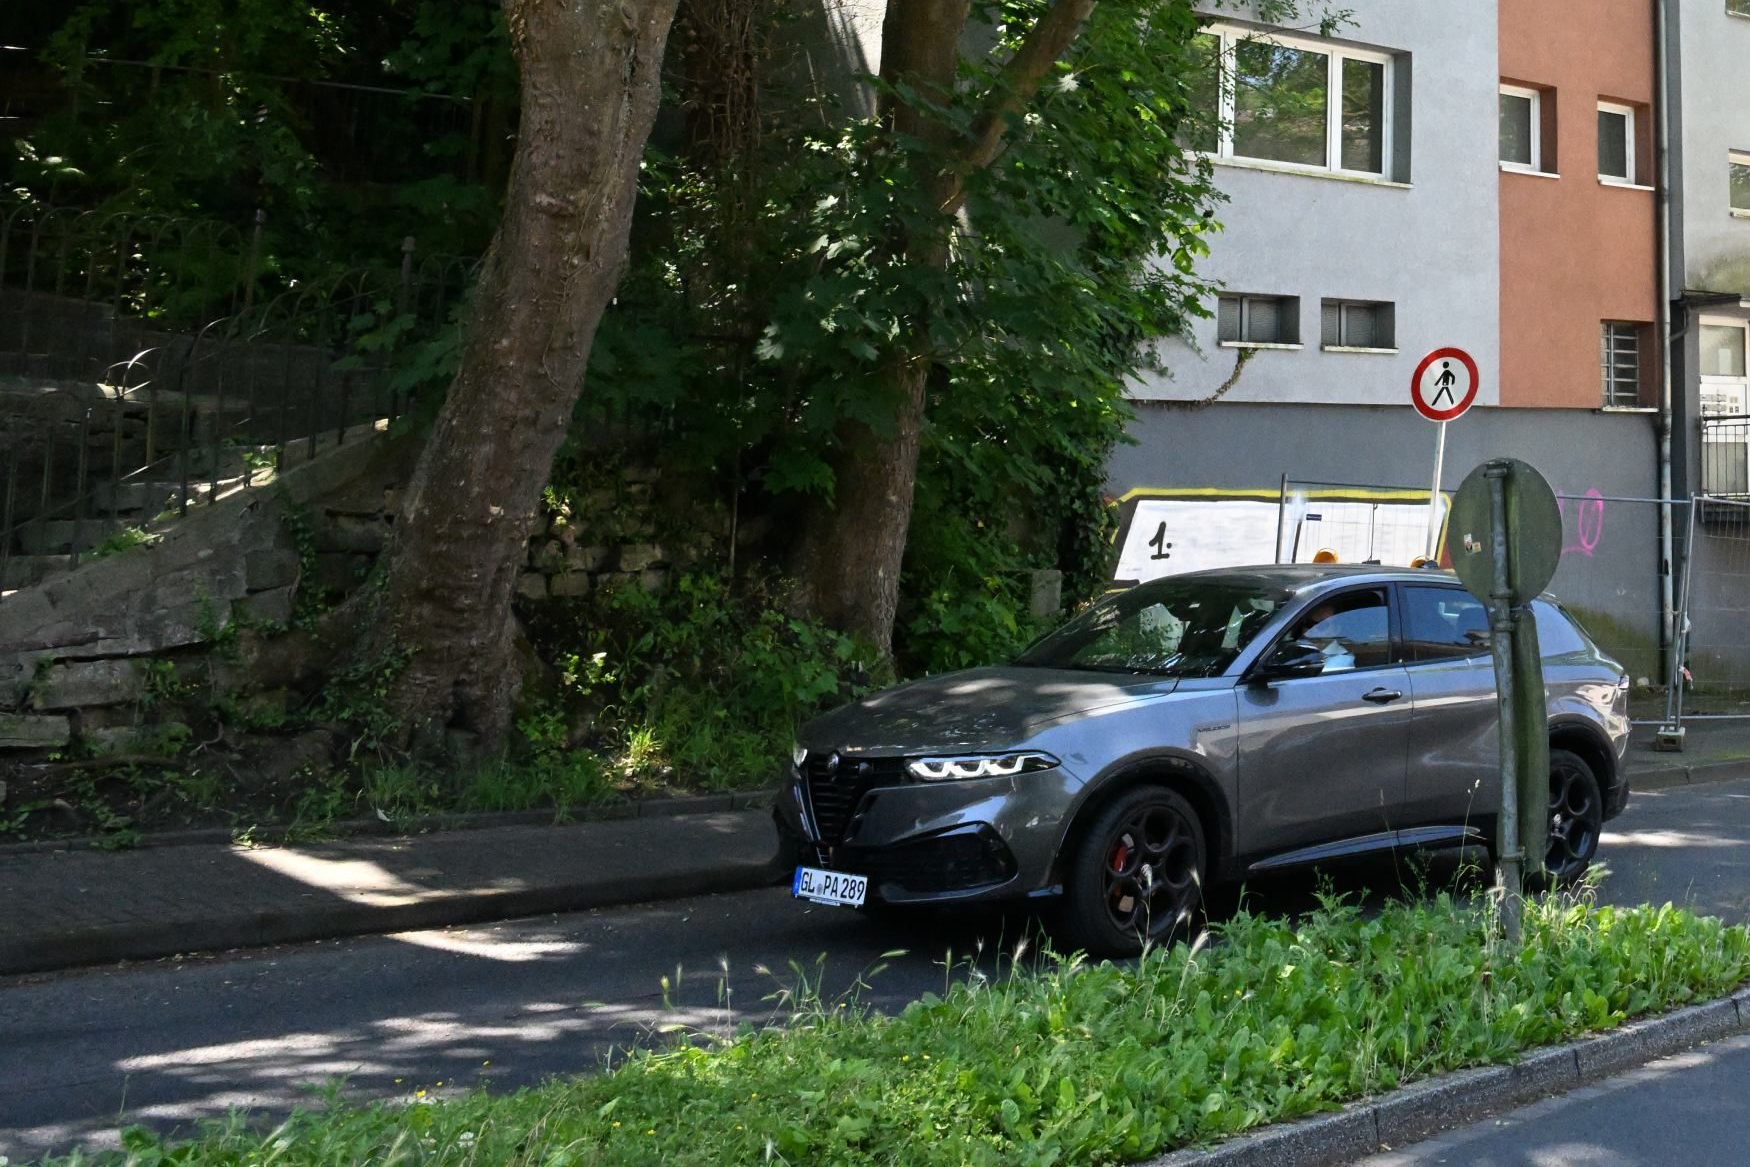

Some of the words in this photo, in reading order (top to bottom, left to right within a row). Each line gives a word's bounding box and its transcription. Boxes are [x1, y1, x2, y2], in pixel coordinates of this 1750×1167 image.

[801, 871, 815, 893] GL
[823, 874, 839, 898] PA
[840, 878, 865, 901] 289
